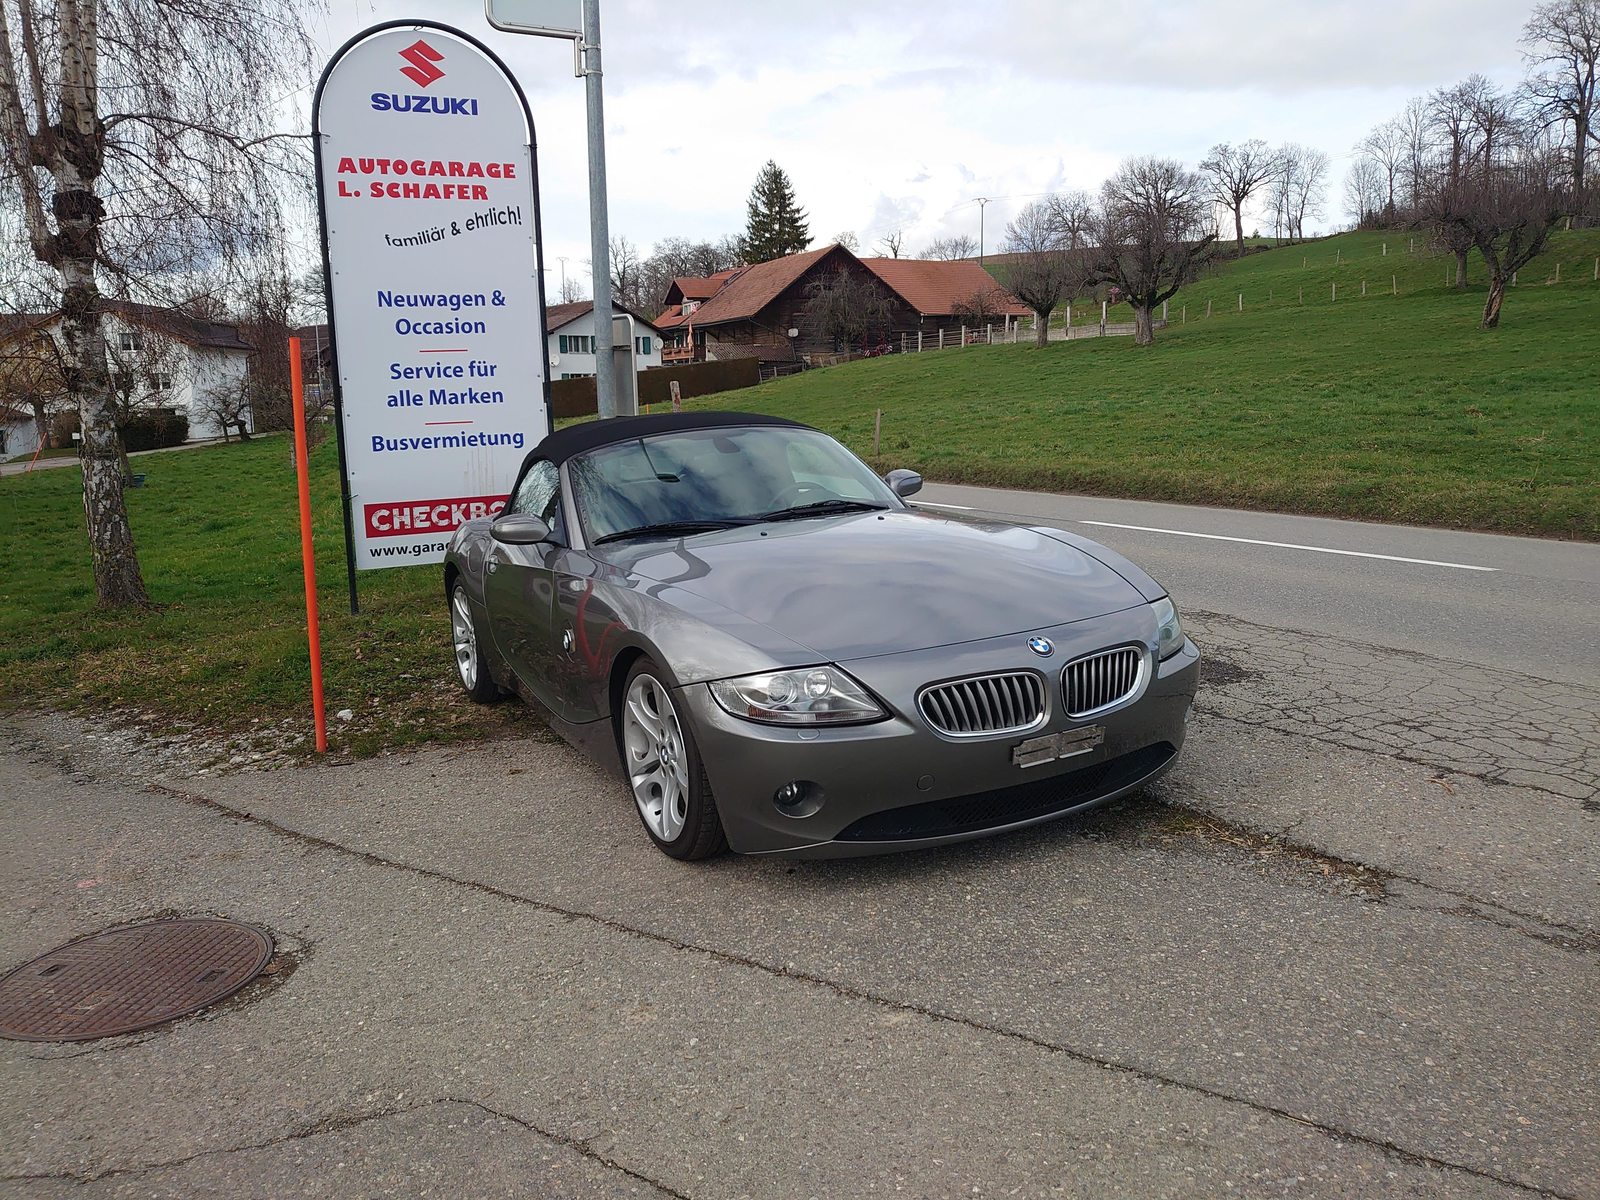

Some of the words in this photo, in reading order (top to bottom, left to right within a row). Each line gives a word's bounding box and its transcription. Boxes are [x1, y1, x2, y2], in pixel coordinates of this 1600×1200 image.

[371, 93, 478, 116] SUZUKI
[337, 157, 516, 179] AUTOGARAGE
[338, 181, 361, 198] L.
[370, 182, 489, 201] SCHAFER
[385, 226, 446, 248] familiär
[451, 221, 462, 236] &
[466, 205, 522, 231] ehrlich!
[377, 290, 486, 311] Neuwagen
[491, 290, 506, 306] &
[395, 318, 486, 335] Occasion
[390, 361, 464, 380] Service
[468, 360, 497, 377] für
[387, 390, 424, 407] alle
[429, 387, 504, 405] Marken
[371, 431, 524, 452] Busvermietung
[369, 541, 450, 557] www.gara
